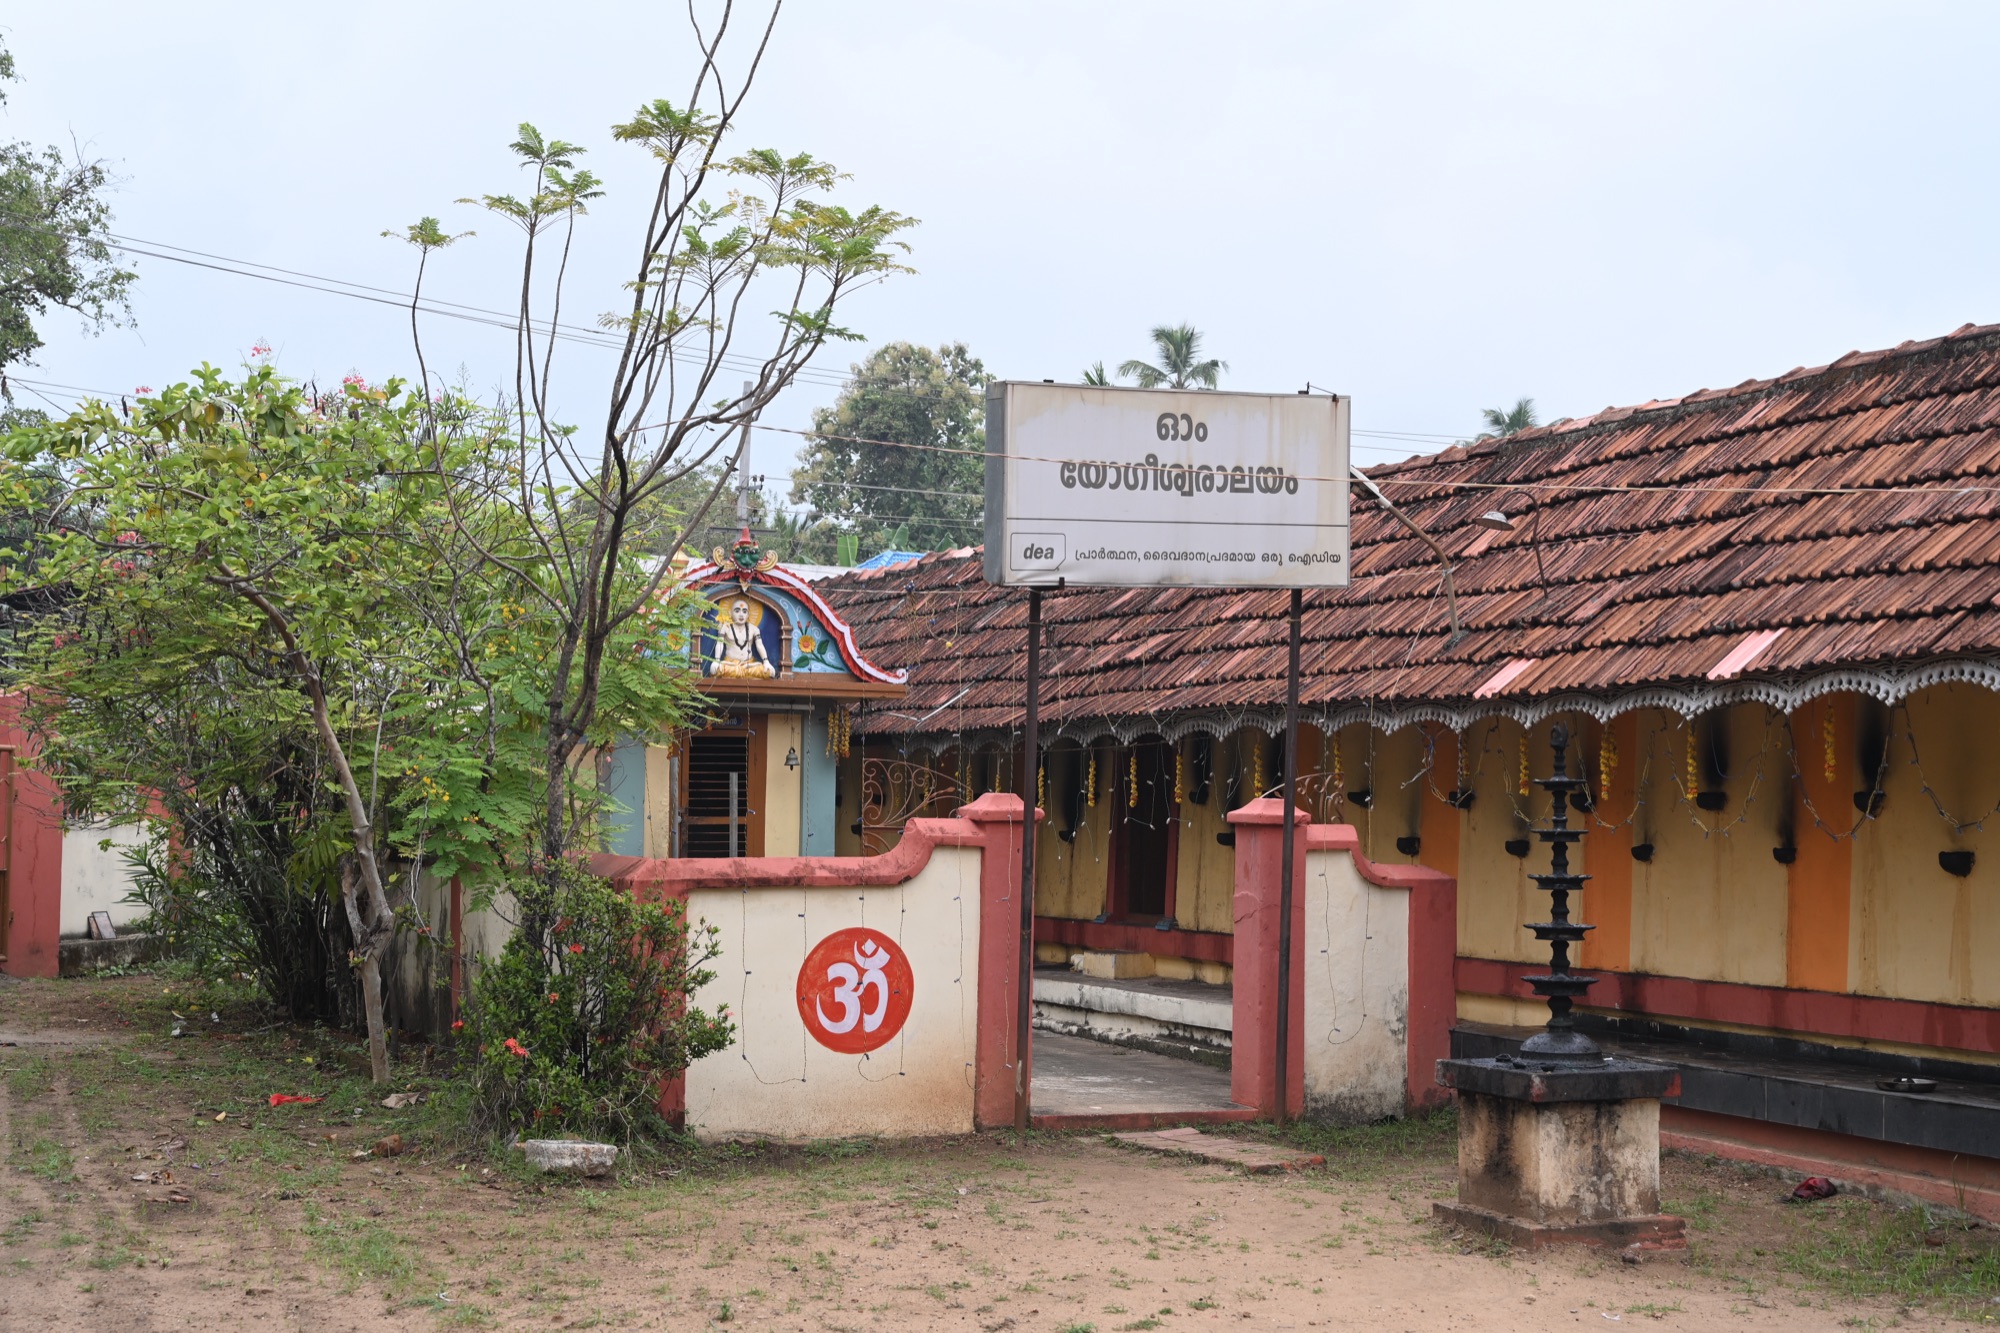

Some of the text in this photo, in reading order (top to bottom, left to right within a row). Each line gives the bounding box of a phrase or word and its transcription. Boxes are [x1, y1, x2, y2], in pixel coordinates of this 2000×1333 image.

[1156, 412, 1208, 443] ഓം
[1060, 453, 1299, 497] യോഗീശ്വരാലയം
[1023, 543, 1055, 560] dea
[1261, 552, 1283, 566] ഒരു
[1288, 551, 1341, 566] ഐഡിയ
